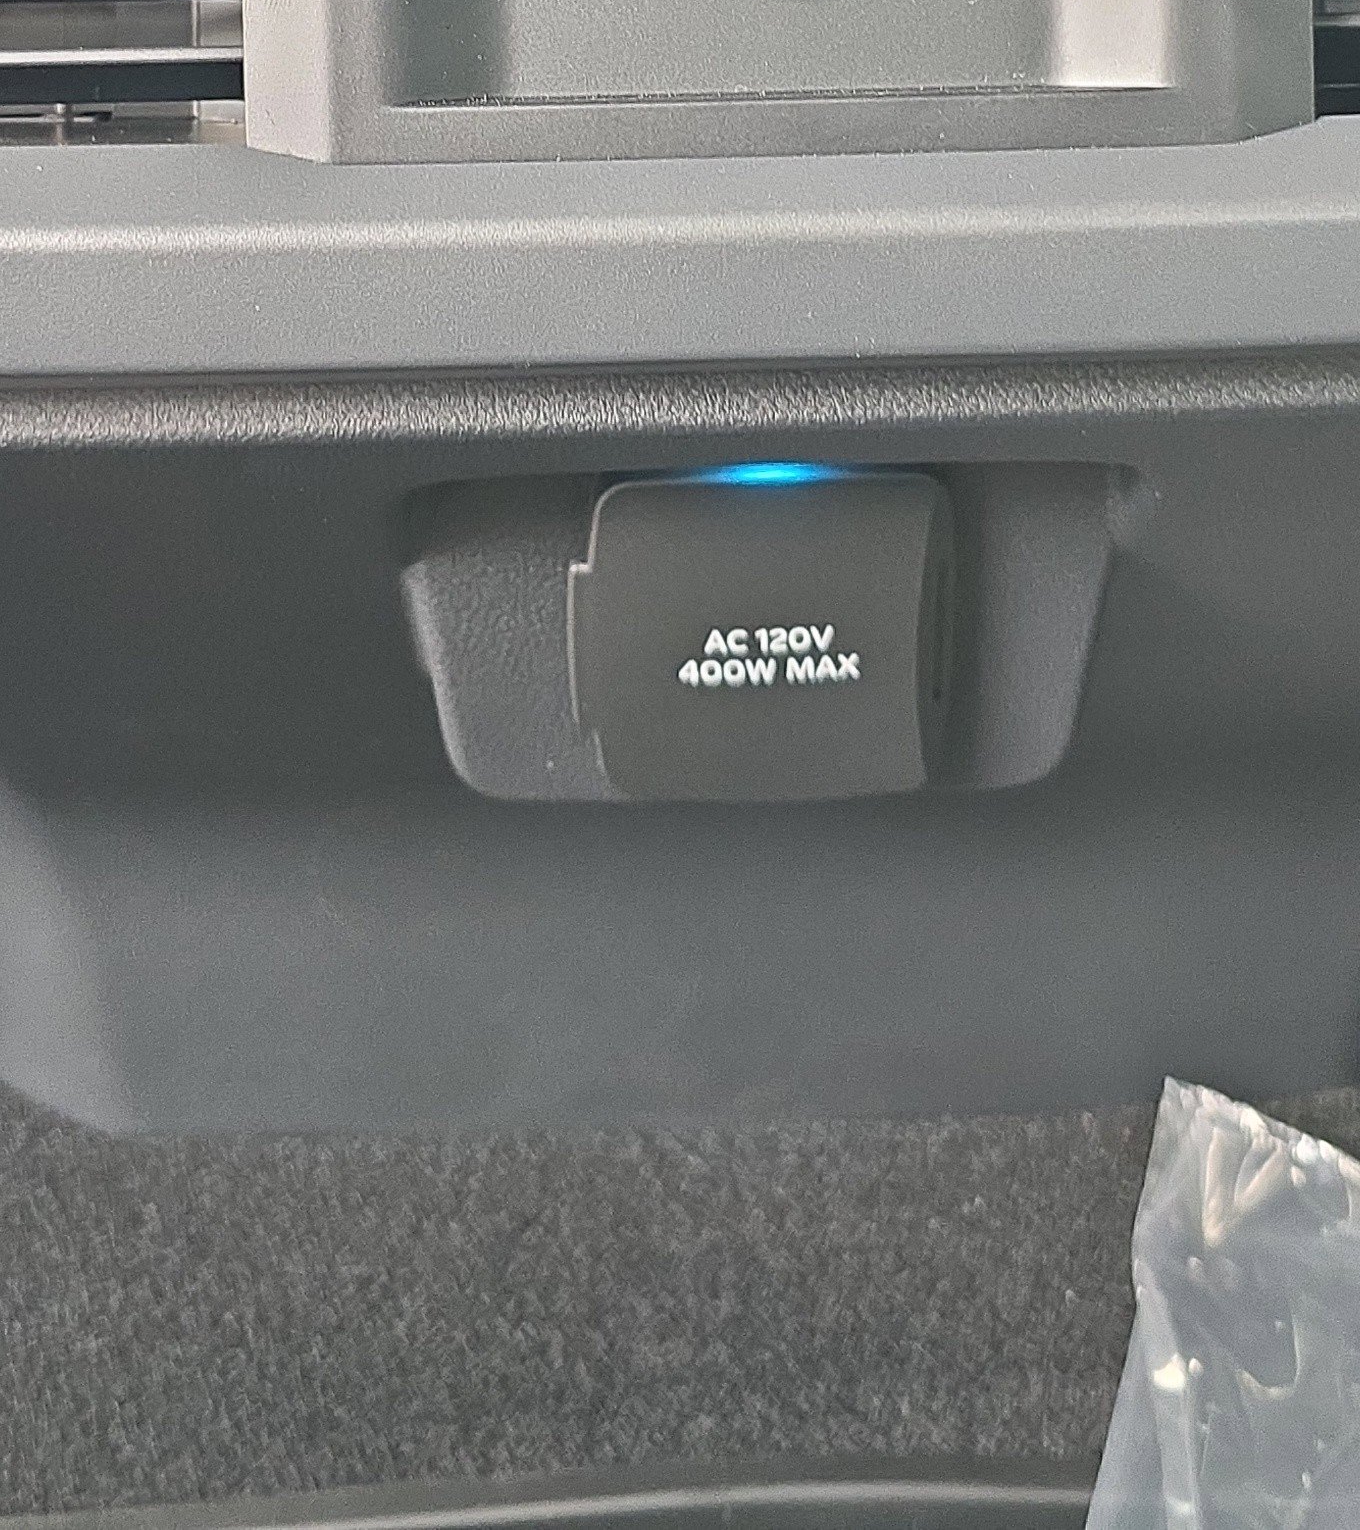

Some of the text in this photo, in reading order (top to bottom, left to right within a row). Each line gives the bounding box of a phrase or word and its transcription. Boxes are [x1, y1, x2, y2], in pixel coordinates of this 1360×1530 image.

[704, 624, 835, 657] AC 120V
[678, 652, 861, 687] 400W MAX
